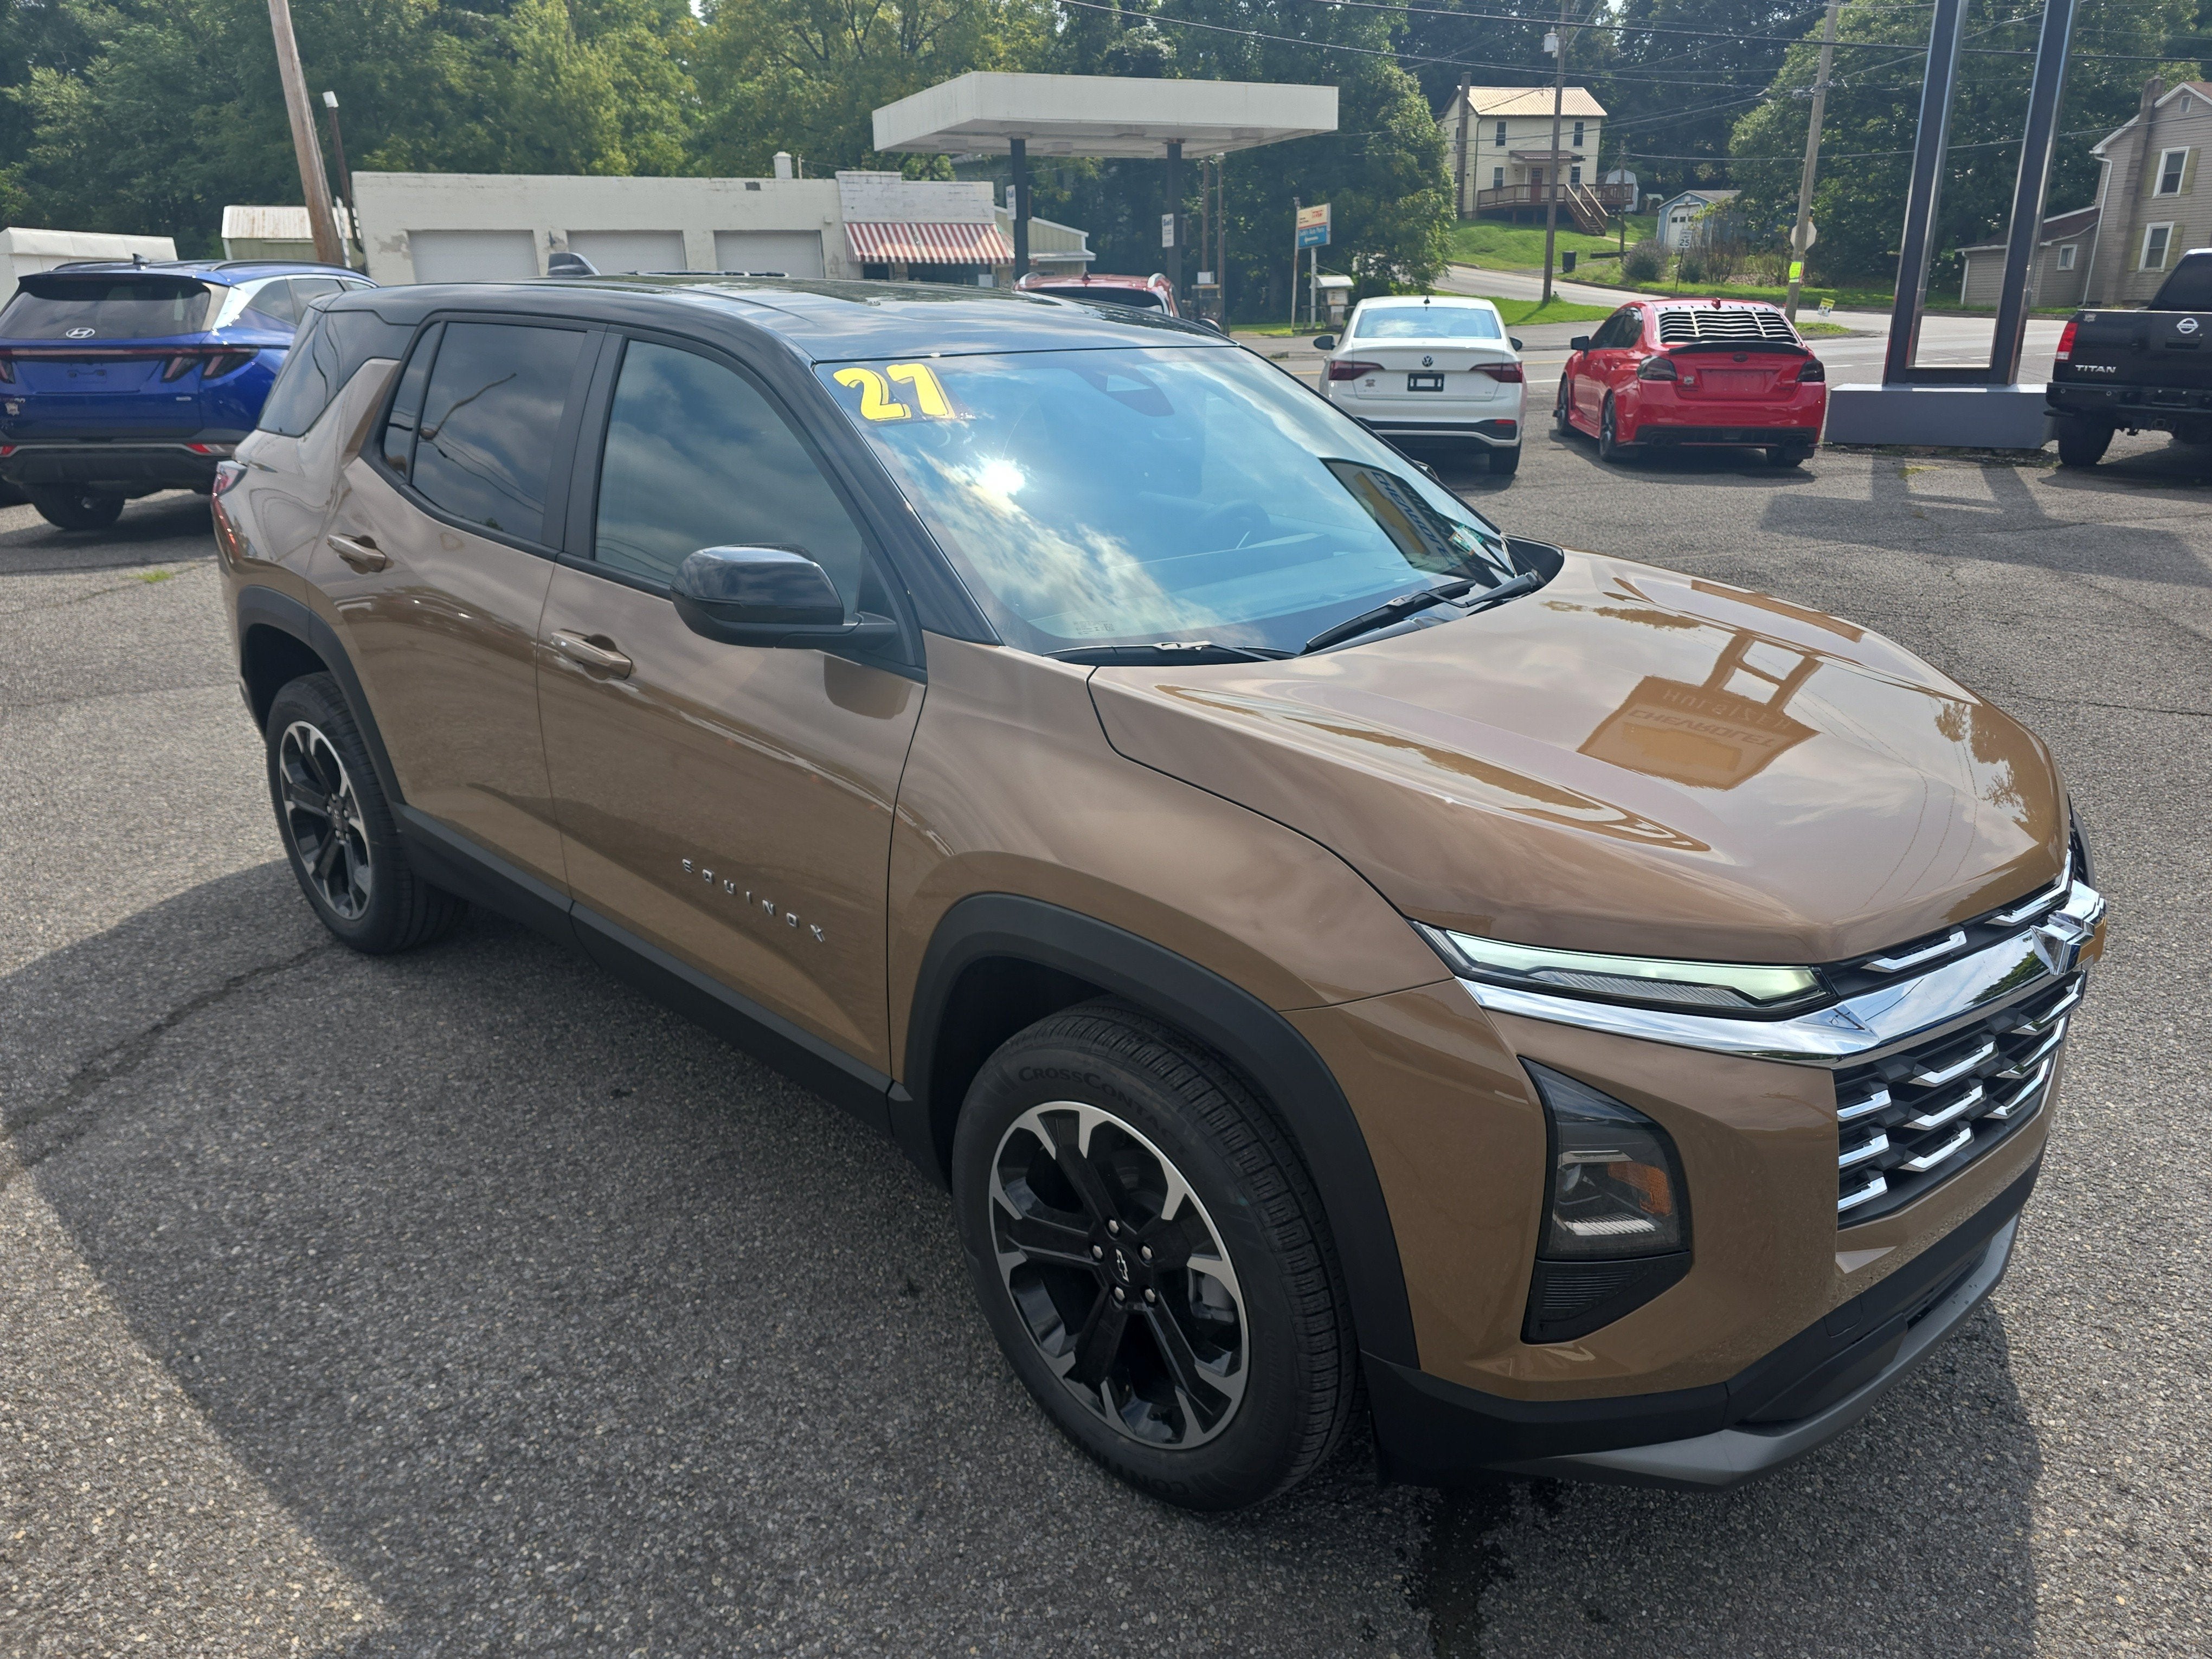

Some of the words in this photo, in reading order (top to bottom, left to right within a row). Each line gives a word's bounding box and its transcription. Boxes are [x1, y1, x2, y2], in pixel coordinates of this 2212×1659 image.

[833, 363, 955, 421] 27
[2075, 364, 2117, 373] TITAN
[681, 858, 825, 942] EQUINOX
